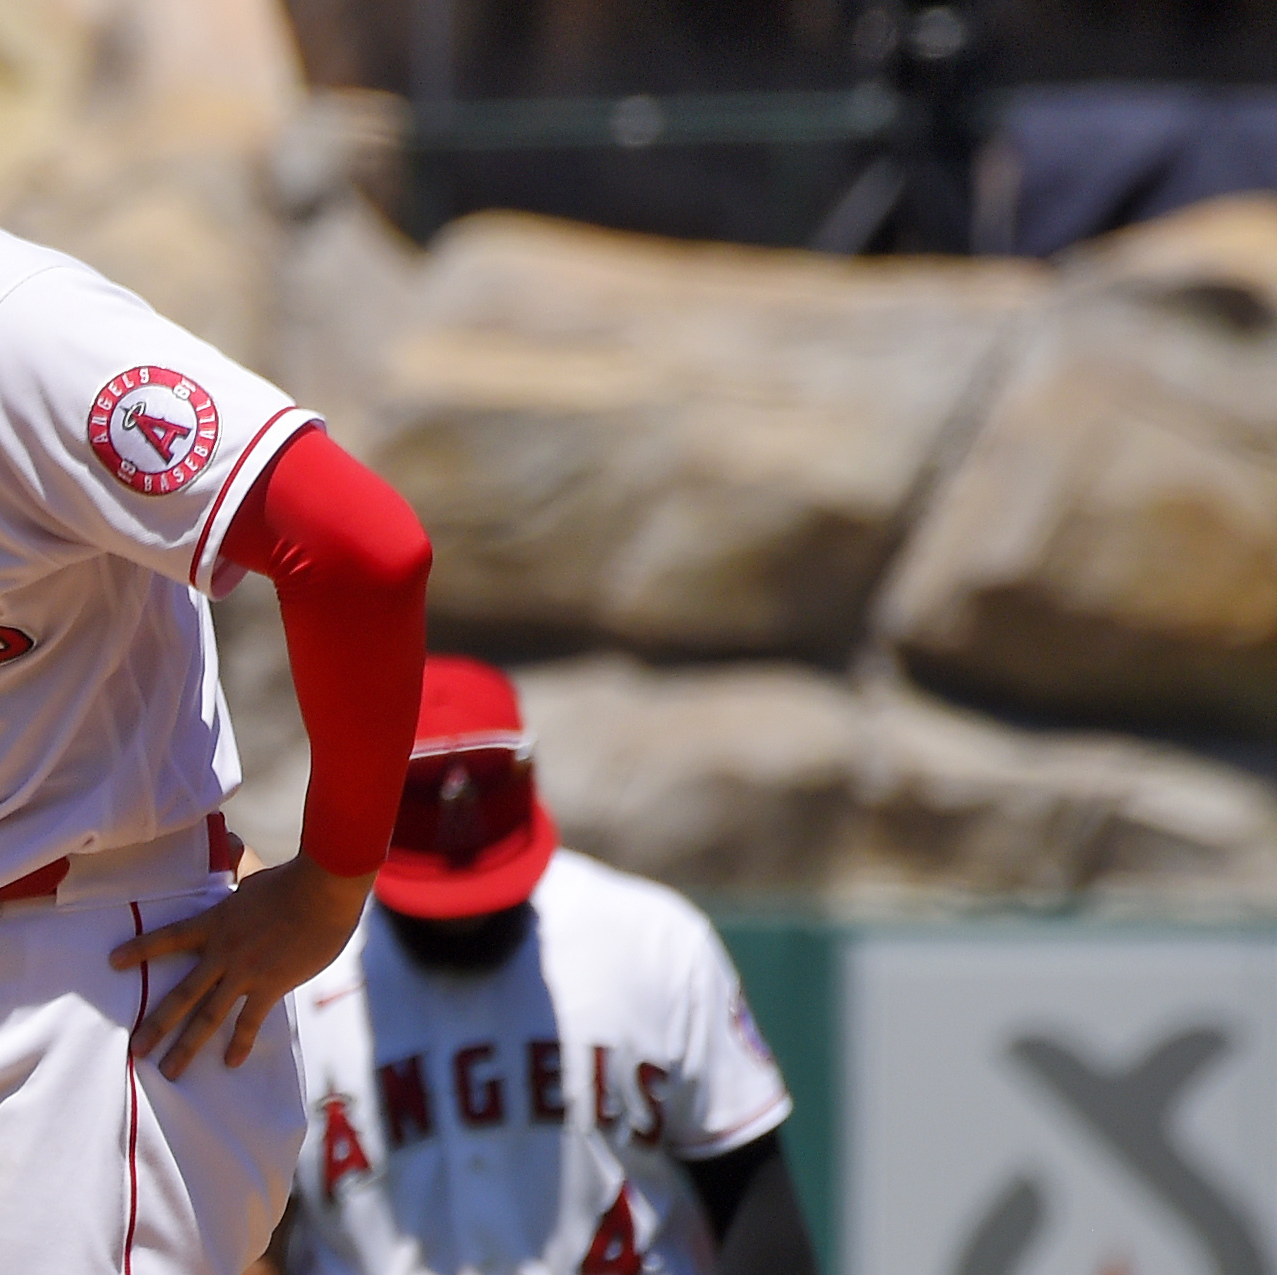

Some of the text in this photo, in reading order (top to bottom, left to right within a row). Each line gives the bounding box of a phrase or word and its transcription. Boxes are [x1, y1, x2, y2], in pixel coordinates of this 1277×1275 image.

[91, 367, 150, 444] ANGELS
[123, 402, 193, 466] A
[144, 398, 216, 492] BASEBALL
[318, 1040, 668, 1204] ANGELS
